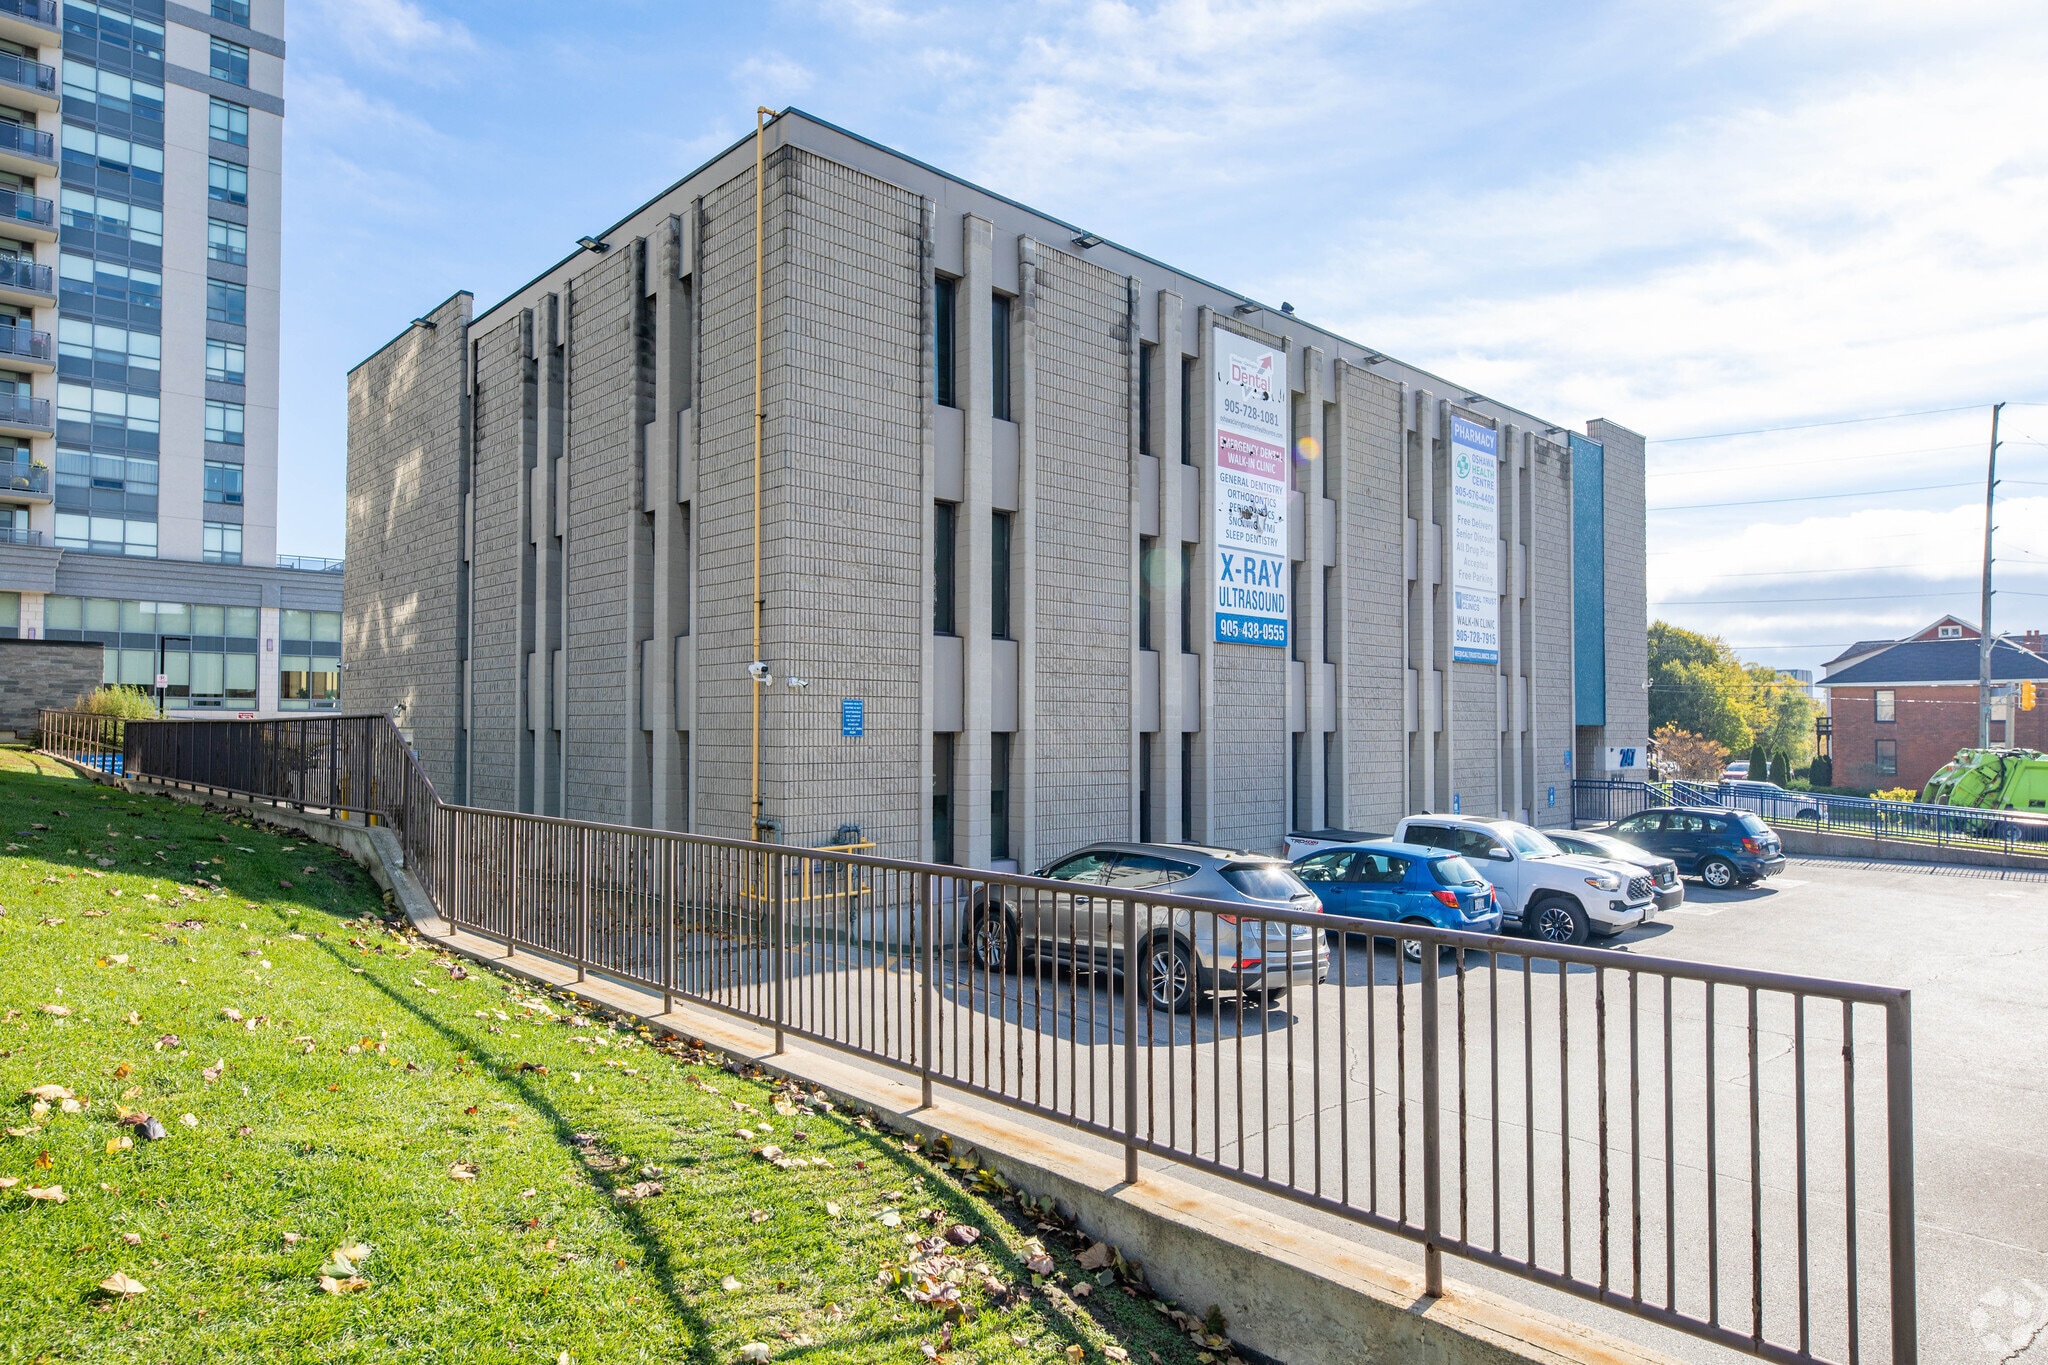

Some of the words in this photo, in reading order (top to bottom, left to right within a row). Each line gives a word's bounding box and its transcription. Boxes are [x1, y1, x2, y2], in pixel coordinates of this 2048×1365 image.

[1232, 363, 1271, 392] Dental
[1224, 398, 1279, 427] 905-728-1081
[1454, 423, 1495, 449] PHARMACY
[1219, 436, 1260, 456] EMERGENCY
[1260, 446, 1283, 463] DENTAL
[1227, 452, 1255, 470] WALK-IN
[1256, 460, 1276, 474] CLINIC
[1472, 453, 1494, 469] OSHAWA
[1472, 464, 1494, 480] HEALTH
[1219, 472, 1249, 488] GENERAL
[1250, 479, 1283, 496] DENTISTRY
[1471, 475, 1494, 491] CENTRE
[1227, 488, 1277, 508] ORTHODONTICS
[1456, 527, 1473, 539] Senior
[1457, 514, 1471, 526] Free
[1471, 518, 1494, 533] Delivery
[1225, 528, 1245, 541] SLEEP
[1245, 532, 1279, 548] DENTISTRY
[1456, 542, 1465, 552] All
[1465, 543, 1479, 557] Drug
[1220, 552, 1283, 589] X-RAY
[1463, 557, 1489, 571] Accepted
[1458, 569, 1472, 581] Free
[1472, 571, 1494, 587] Parking
[1219, 585, 1285, 614] ULTRASOUND
[1220, 618, 1285, 641] 905-438-0555
[1456, 615, 1479, 628] WALK-IN
[1479, 618, 1495, 630] CLINIC
